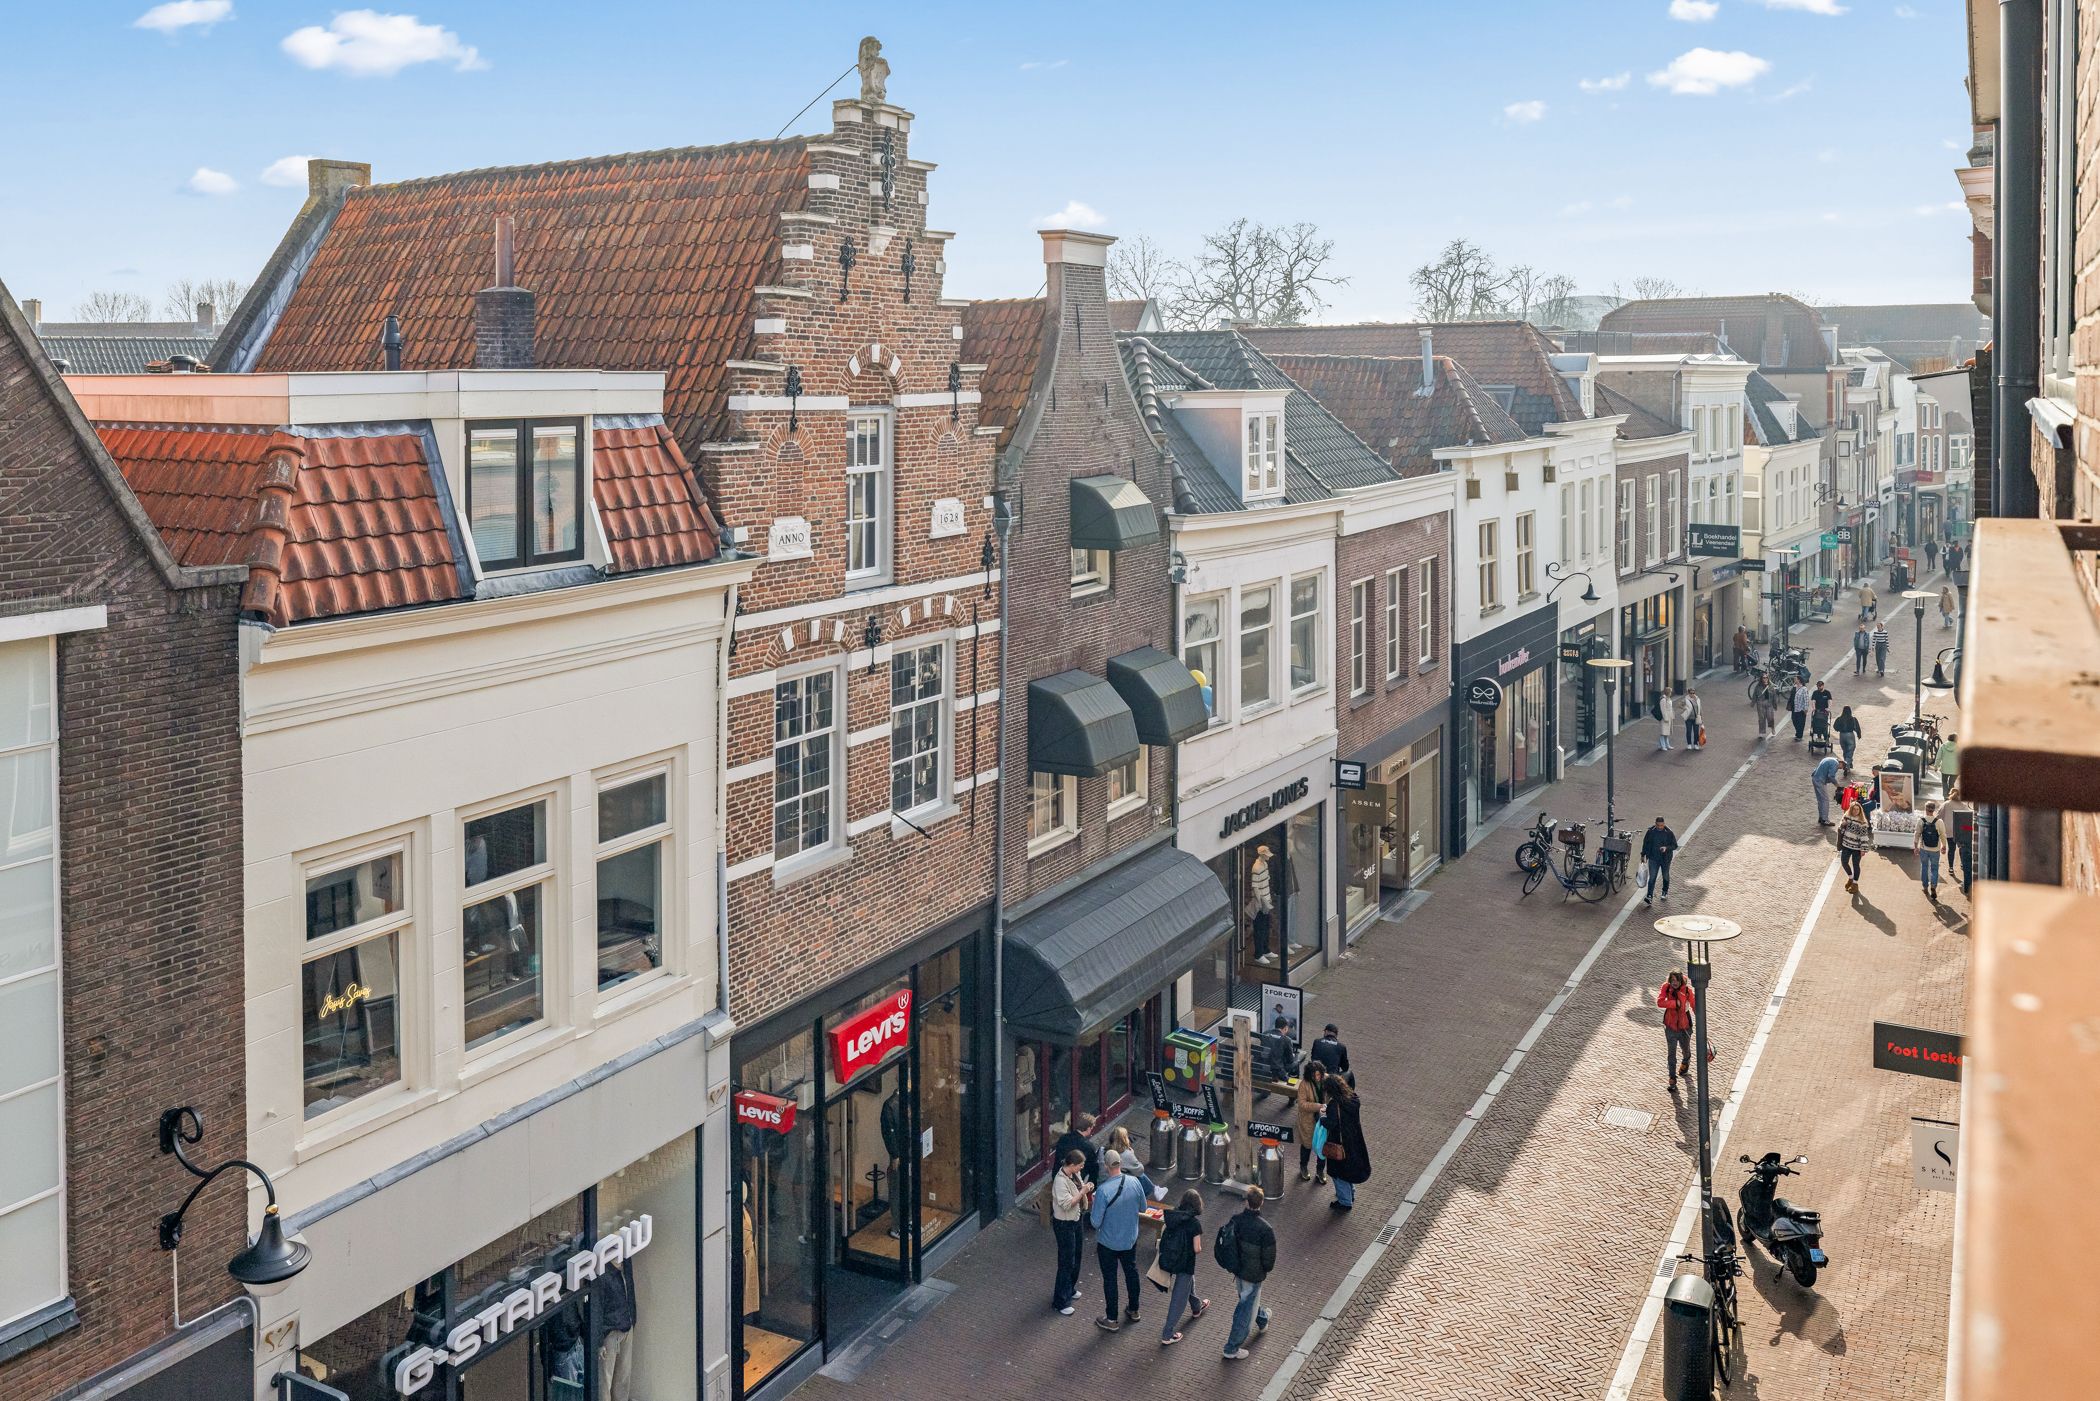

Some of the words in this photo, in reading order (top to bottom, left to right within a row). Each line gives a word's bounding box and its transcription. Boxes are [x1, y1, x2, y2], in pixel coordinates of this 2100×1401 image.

[939, 513, 959, 524] 1628
[779, 533, 805, 545] ANNO
[1704, 533, 1737, 541] Boekhandel
[1352, 800, 1381, 808] ASSEM
[1363, 863, 1376, 880] SALE
[1923, 1047, 1963, 1065] Locke
[1249, 1123, 1280, 1134] AFFOGATO
[1921, 1166, 1955, 1176] SKIN
[395, 1271, 563, 1396] G-STAR
[566, 1213, 653, 1292] RAW
